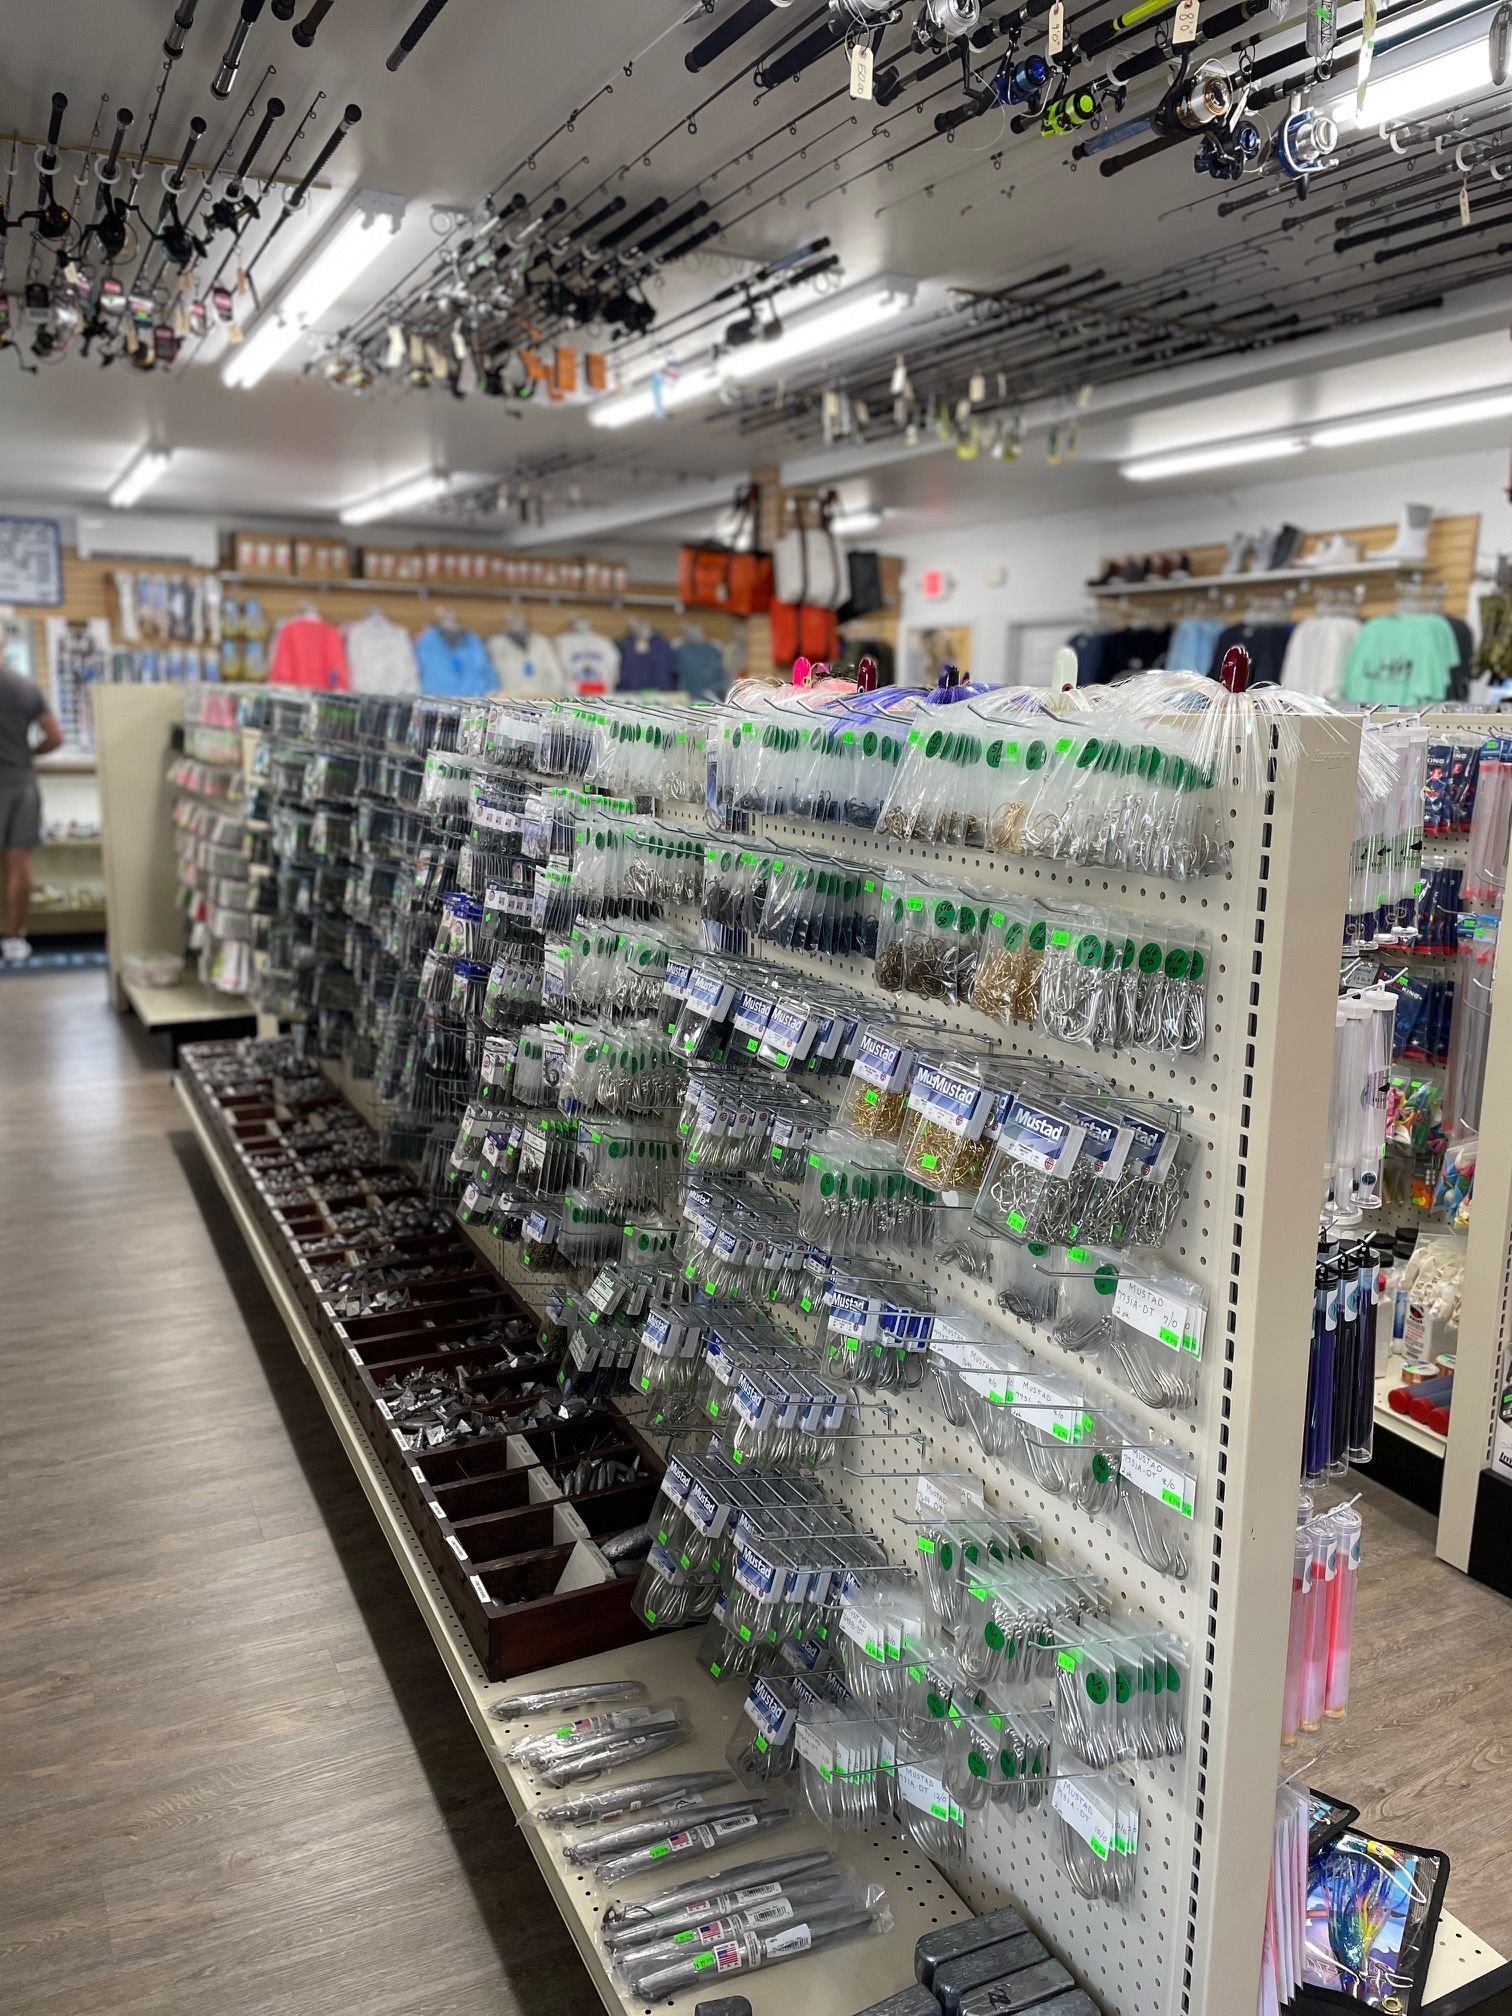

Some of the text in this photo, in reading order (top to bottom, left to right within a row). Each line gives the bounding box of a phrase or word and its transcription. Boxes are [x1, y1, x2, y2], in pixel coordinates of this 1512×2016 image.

[694, 977, 720, 996] Mustad
[742, 994, 771, 1017] Mustad
[772, 1006, 802, 1031] Mustad
[860, 1035, 897, 1062] Mustad
[932, 1075, 976, 1105] Mustad
[1015, 1107, 1064, 1141] Mustad
[648, 1312, 669, 1335] Mustad
[738, 1373, 762, 1405] Mustad
[670, 1459, 691, 1488] Mustad
[693, 1483, 715, 1514] Mustad
[742, 1547, 772, 1579] Mustad
[754, 1678, 783, 1720] Mustad
